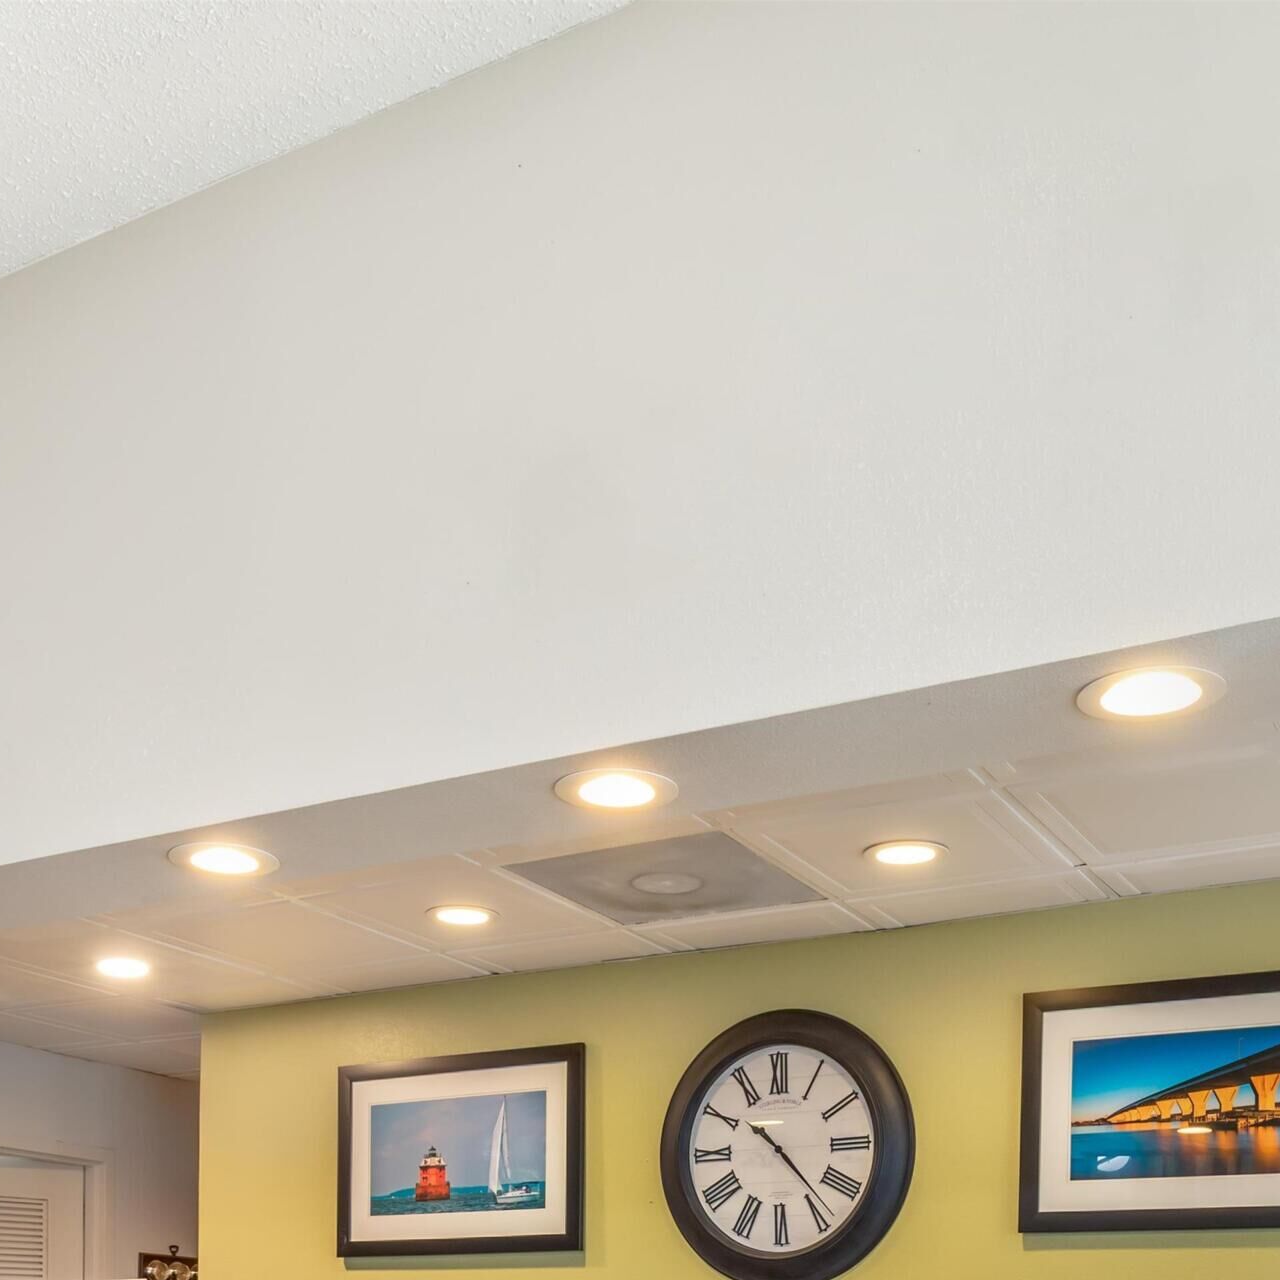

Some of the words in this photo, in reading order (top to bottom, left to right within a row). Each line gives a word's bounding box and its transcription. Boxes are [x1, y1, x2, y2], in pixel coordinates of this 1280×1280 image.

[731, 1065, 762, 1107] XI
[768, 1051, 789, 1095] XII
[703, 1102, 739, 1131] X
[694, 1145, 732, 1164] IX
[830, 1134, 871, 1152] III
[732, 1194, 762, 1239] VII
[774, 1203, 790, 1246] VI
